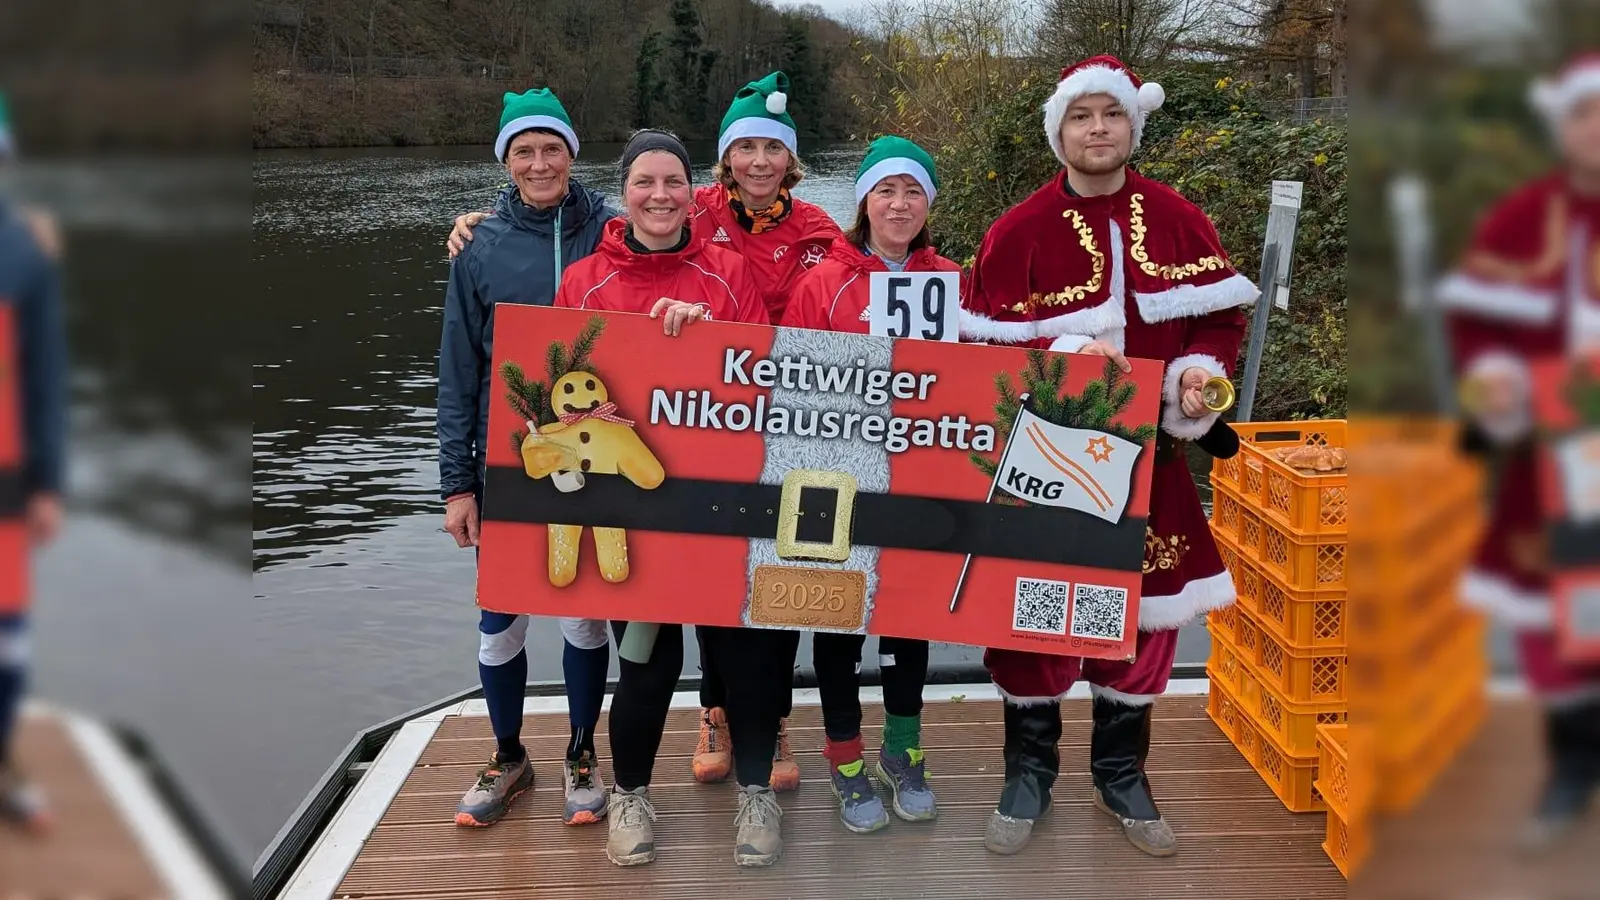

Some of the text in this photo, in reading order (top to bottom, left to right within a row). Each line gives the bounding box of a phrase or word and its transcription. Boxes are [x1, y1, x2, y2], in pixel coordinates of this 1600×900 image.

[887, 277, 946, 341] 59
[723, 348, 936, 405] Kettwiger
[650, 388, 995, 453] Nikolausregatta
[1007, 466, 1065, 500] KRG
[768, 581, 845, 612] 2025
